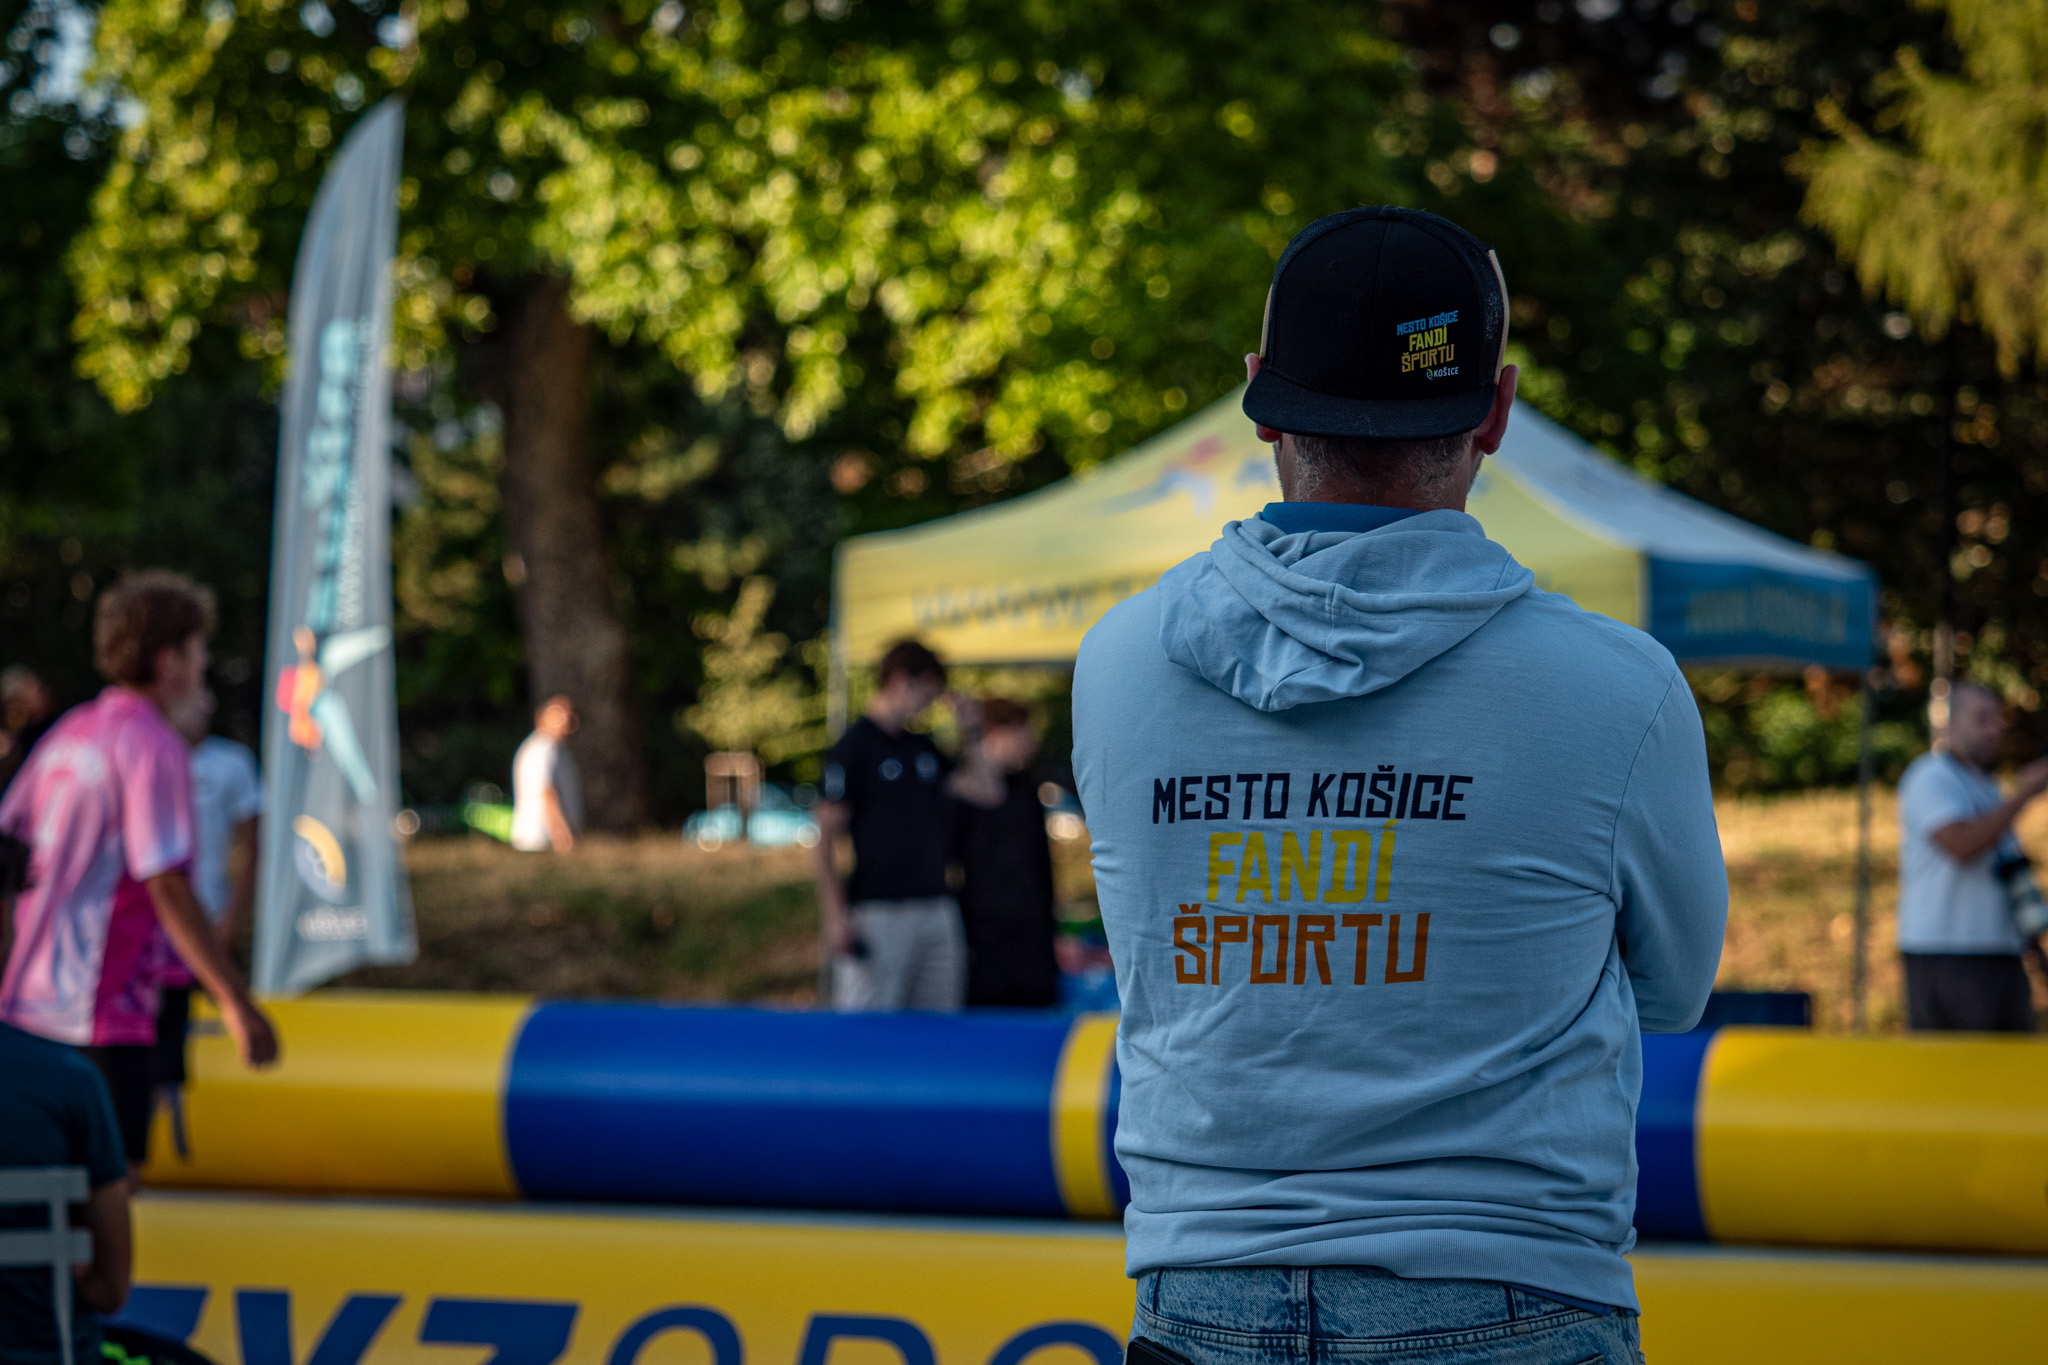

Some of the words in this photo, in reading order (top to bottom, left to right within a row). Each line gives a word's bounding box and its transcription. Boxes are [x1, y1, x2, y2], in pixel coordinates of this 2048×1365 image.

[1396, 318, 1427, 336] MESTO
[1429, 310, 1459, 329] KOŠICE
[1409, 324, 1447, 352] FANDÍ
[1401, 344, 1455, 373] ŠPORTU
[1433, 366, 1459, 378] KOŠICE
[1152, 772, 1291, 824] MESTO
[1306, 764, 1474, 821] KOŠICE
[1206, 818, 1399, 903] FANDÍ
[1173, 903, 1431, 985] ŠPORTU
